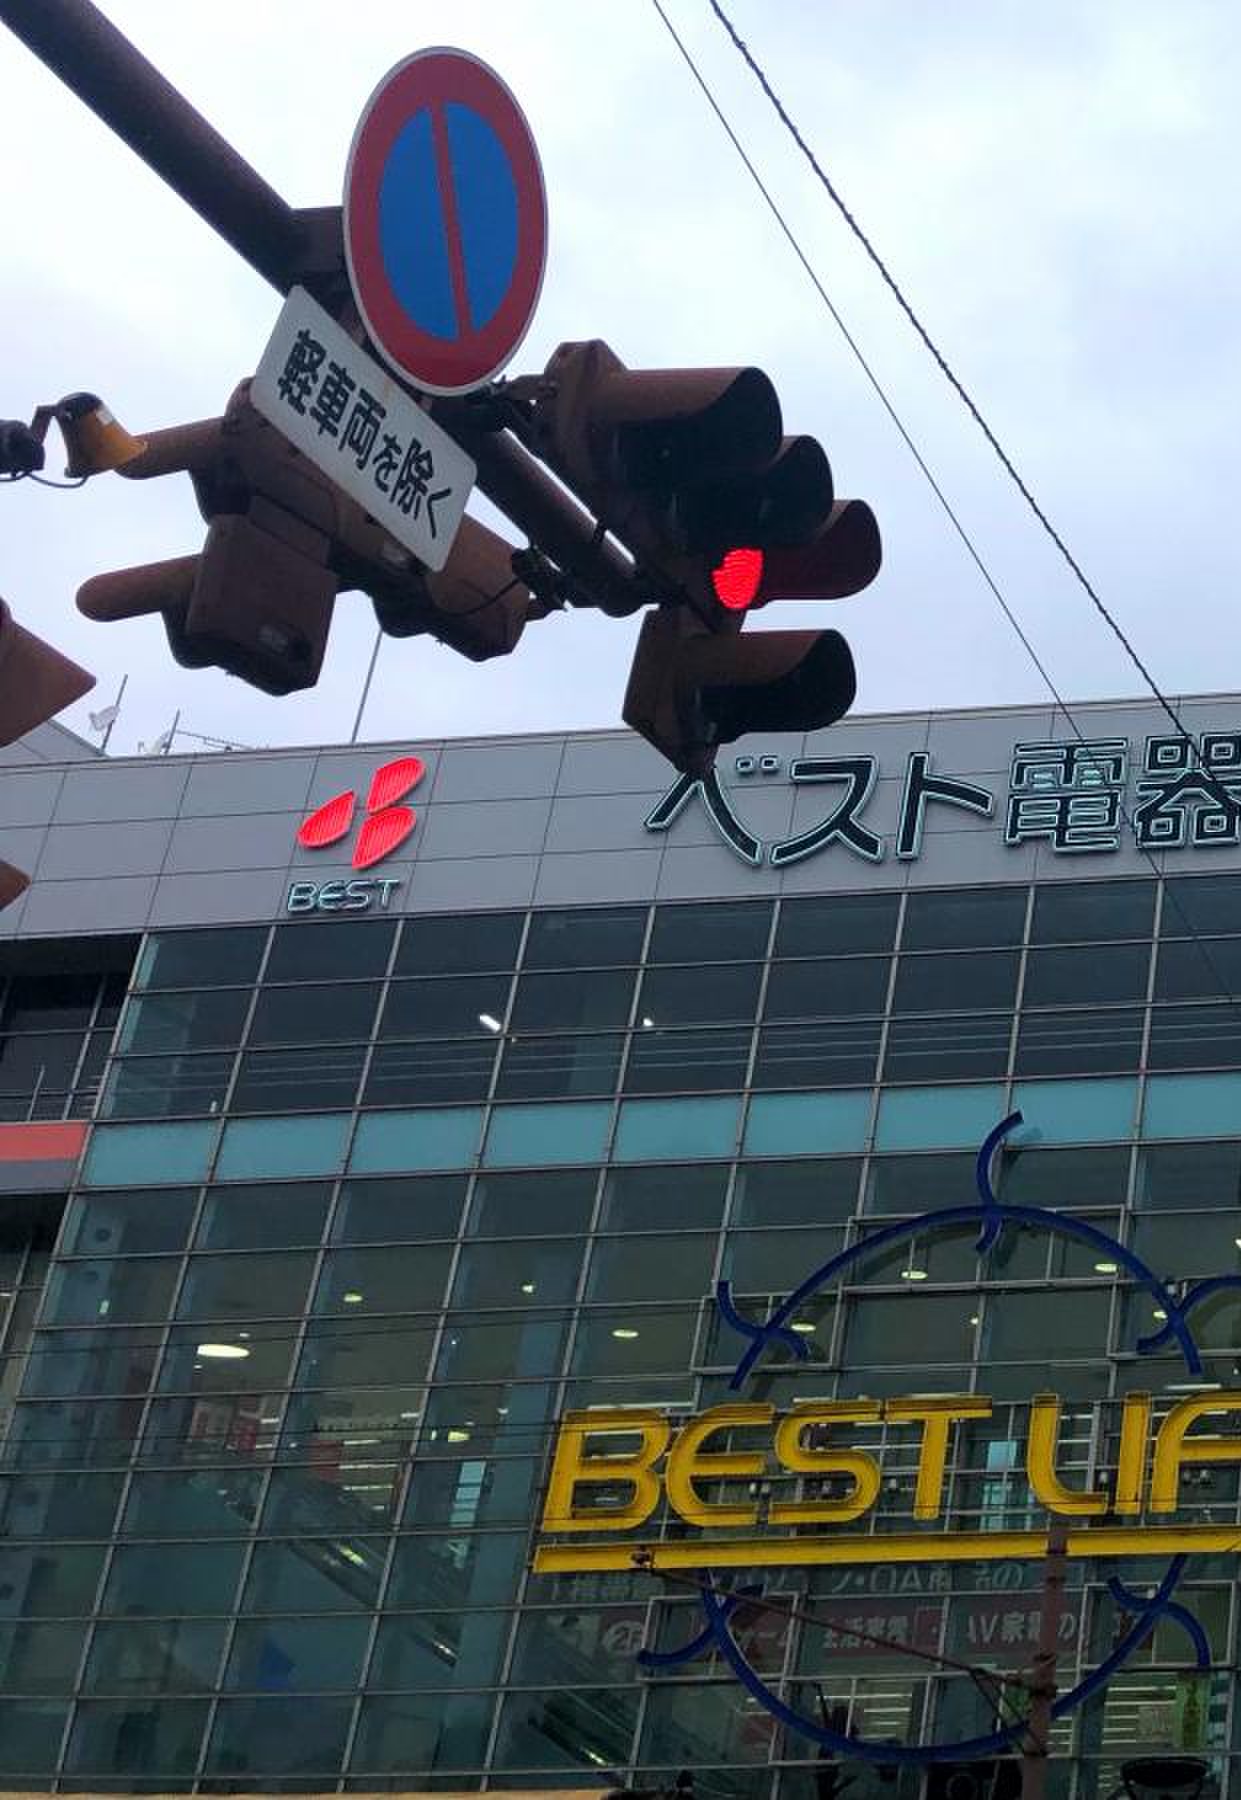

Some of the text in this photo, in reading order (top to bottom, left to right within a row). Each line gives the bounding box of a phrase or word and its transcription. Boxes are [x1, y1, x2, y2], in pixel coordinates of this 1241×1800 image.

[277, 329, 452, 539] 軽車両を除く
[287, 878, 401, 912] BEST
[541, 1391, 992, 1533] BEST
